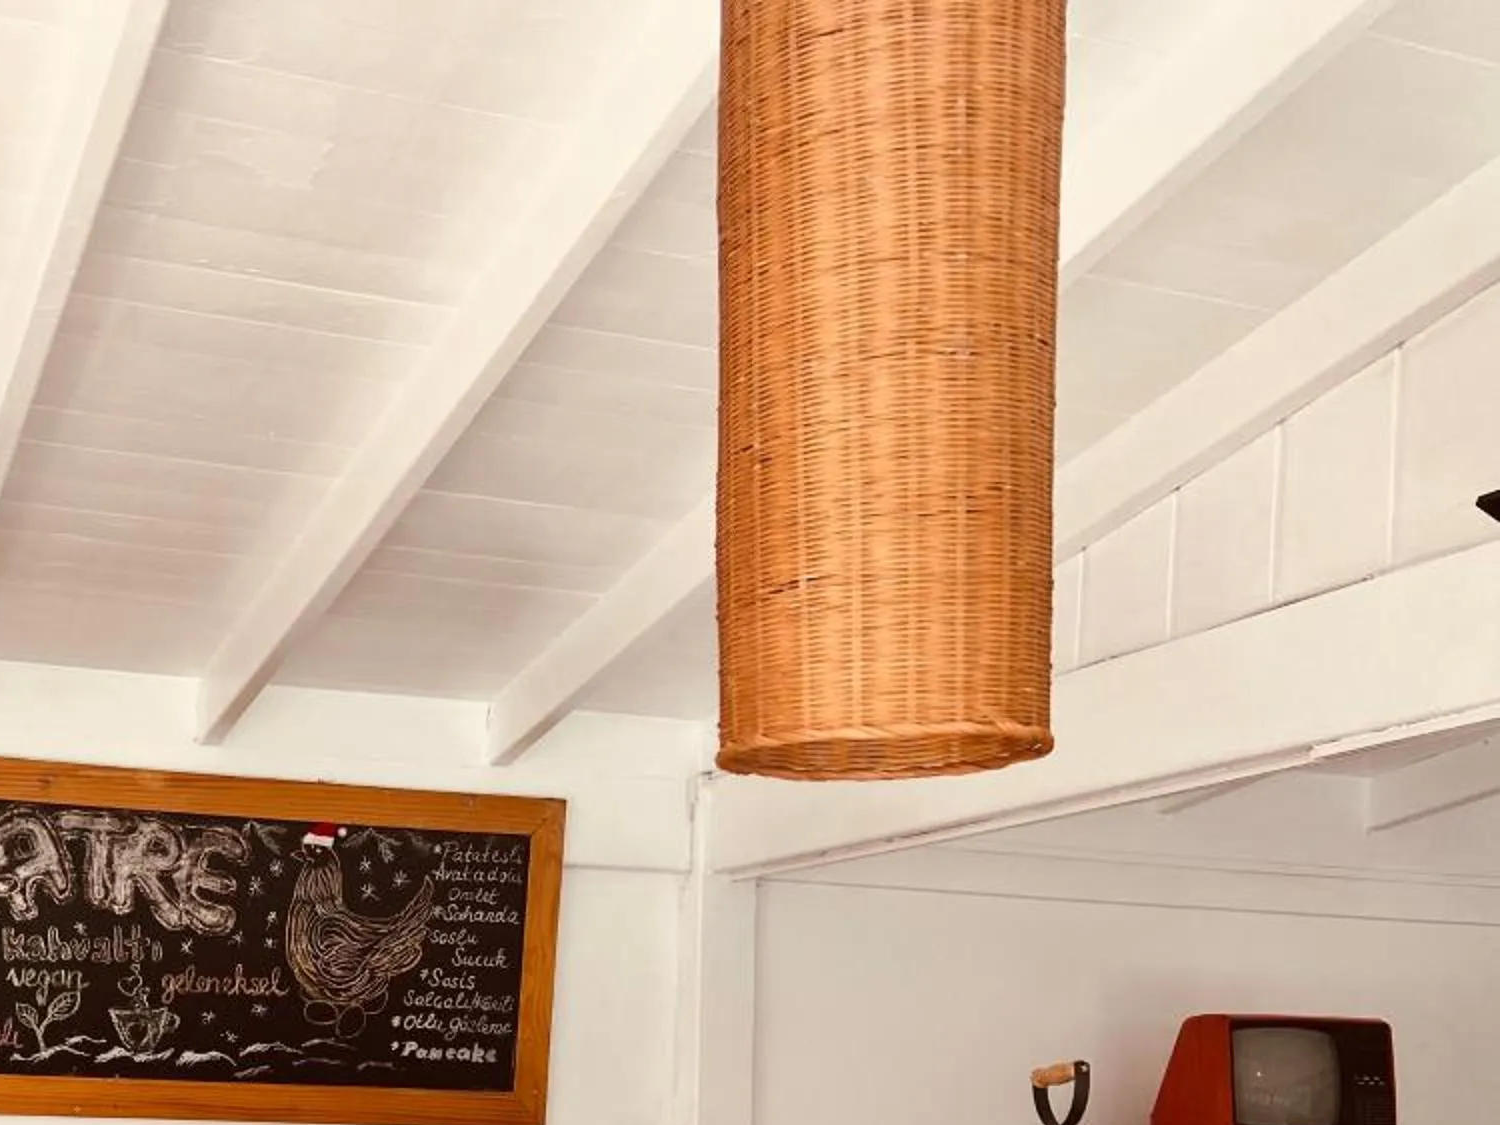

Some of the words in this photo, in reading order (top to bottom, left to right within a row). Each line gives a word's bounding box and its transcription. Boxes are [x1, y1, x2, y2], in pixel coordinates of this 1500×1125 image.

[449, 887, 500, 905] Omlet
[452, 948, 508, 968] Sucuk
[7, 968, 89, 1006] vegan
[161, 963, 290, 1003] geleneksel
[401, 1041, 497, 1063] Pancake
